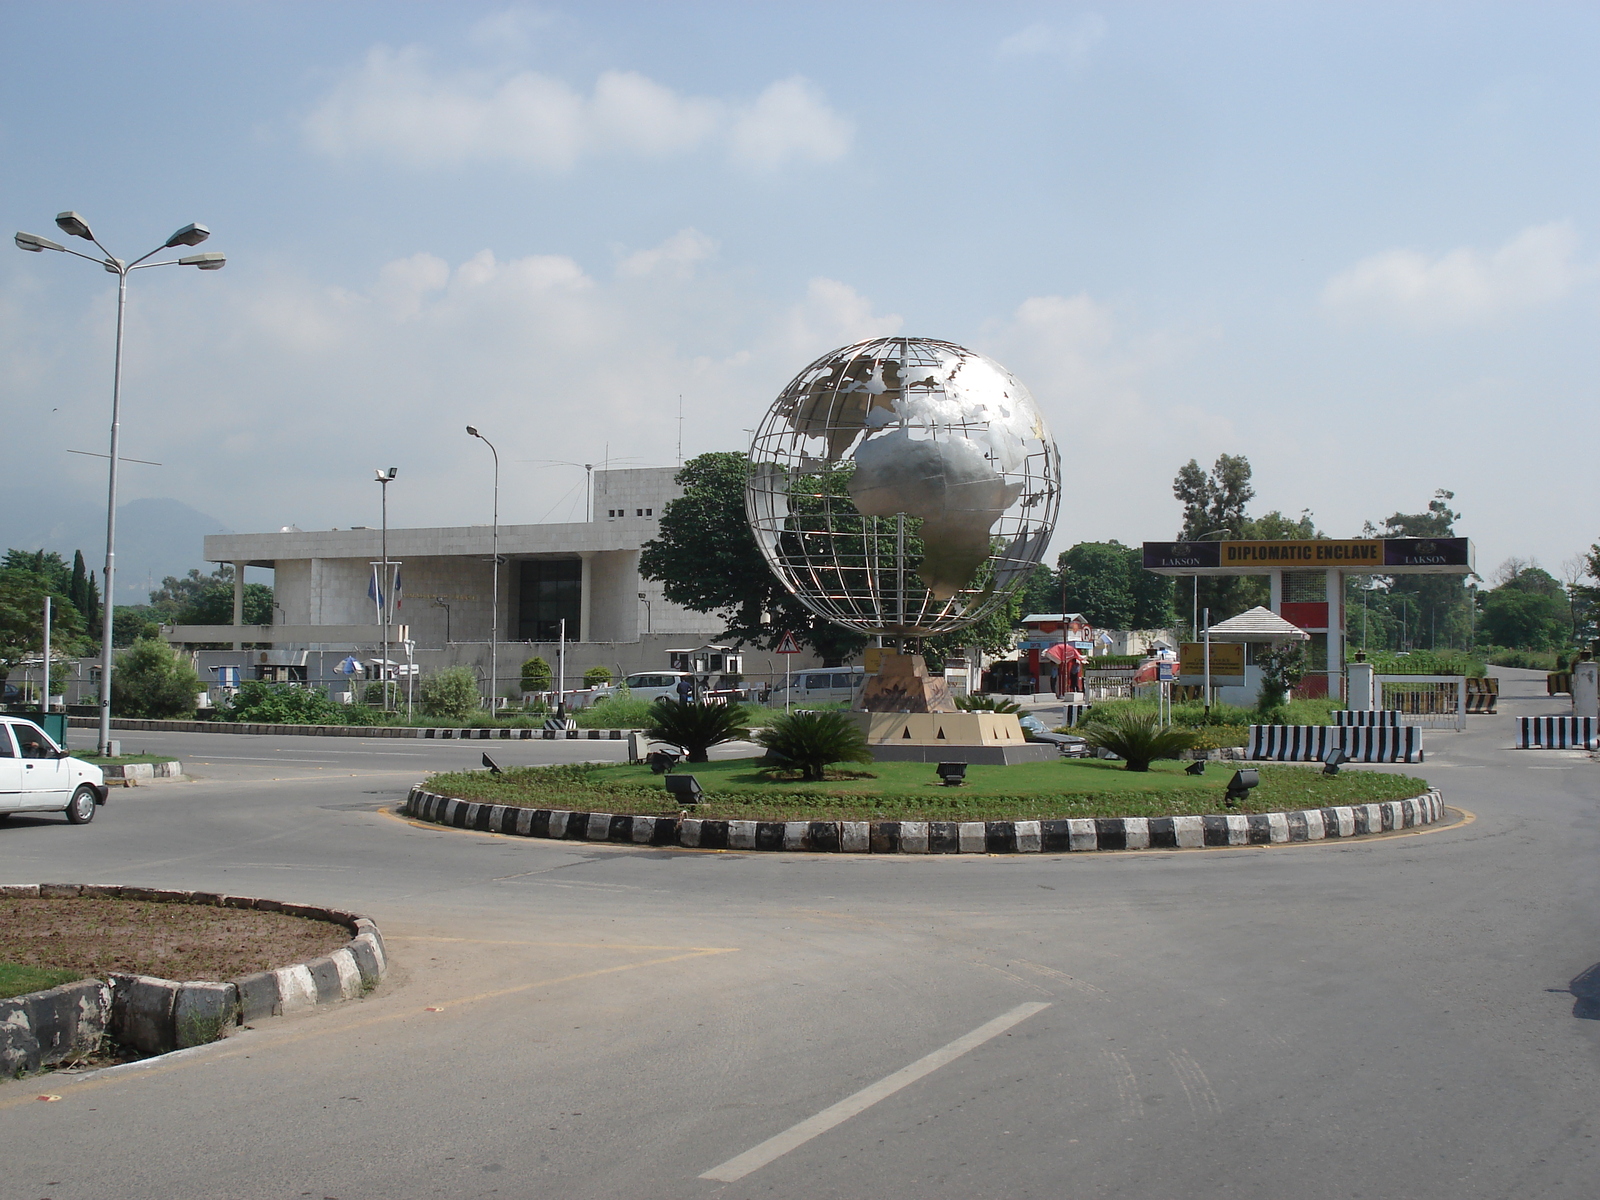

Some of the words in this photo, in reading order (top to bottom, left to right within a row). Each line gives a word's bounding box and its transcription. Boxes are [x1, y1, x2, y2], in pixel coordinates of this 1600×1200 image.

[1228, 546, 1312, 560] DIPLOMATIC
[1316, 545, 1377, 559] ENCLAVE
[1162, 558, 1200, 566] LAKSON
[1405, 555, 1447, 564] LAKSON
